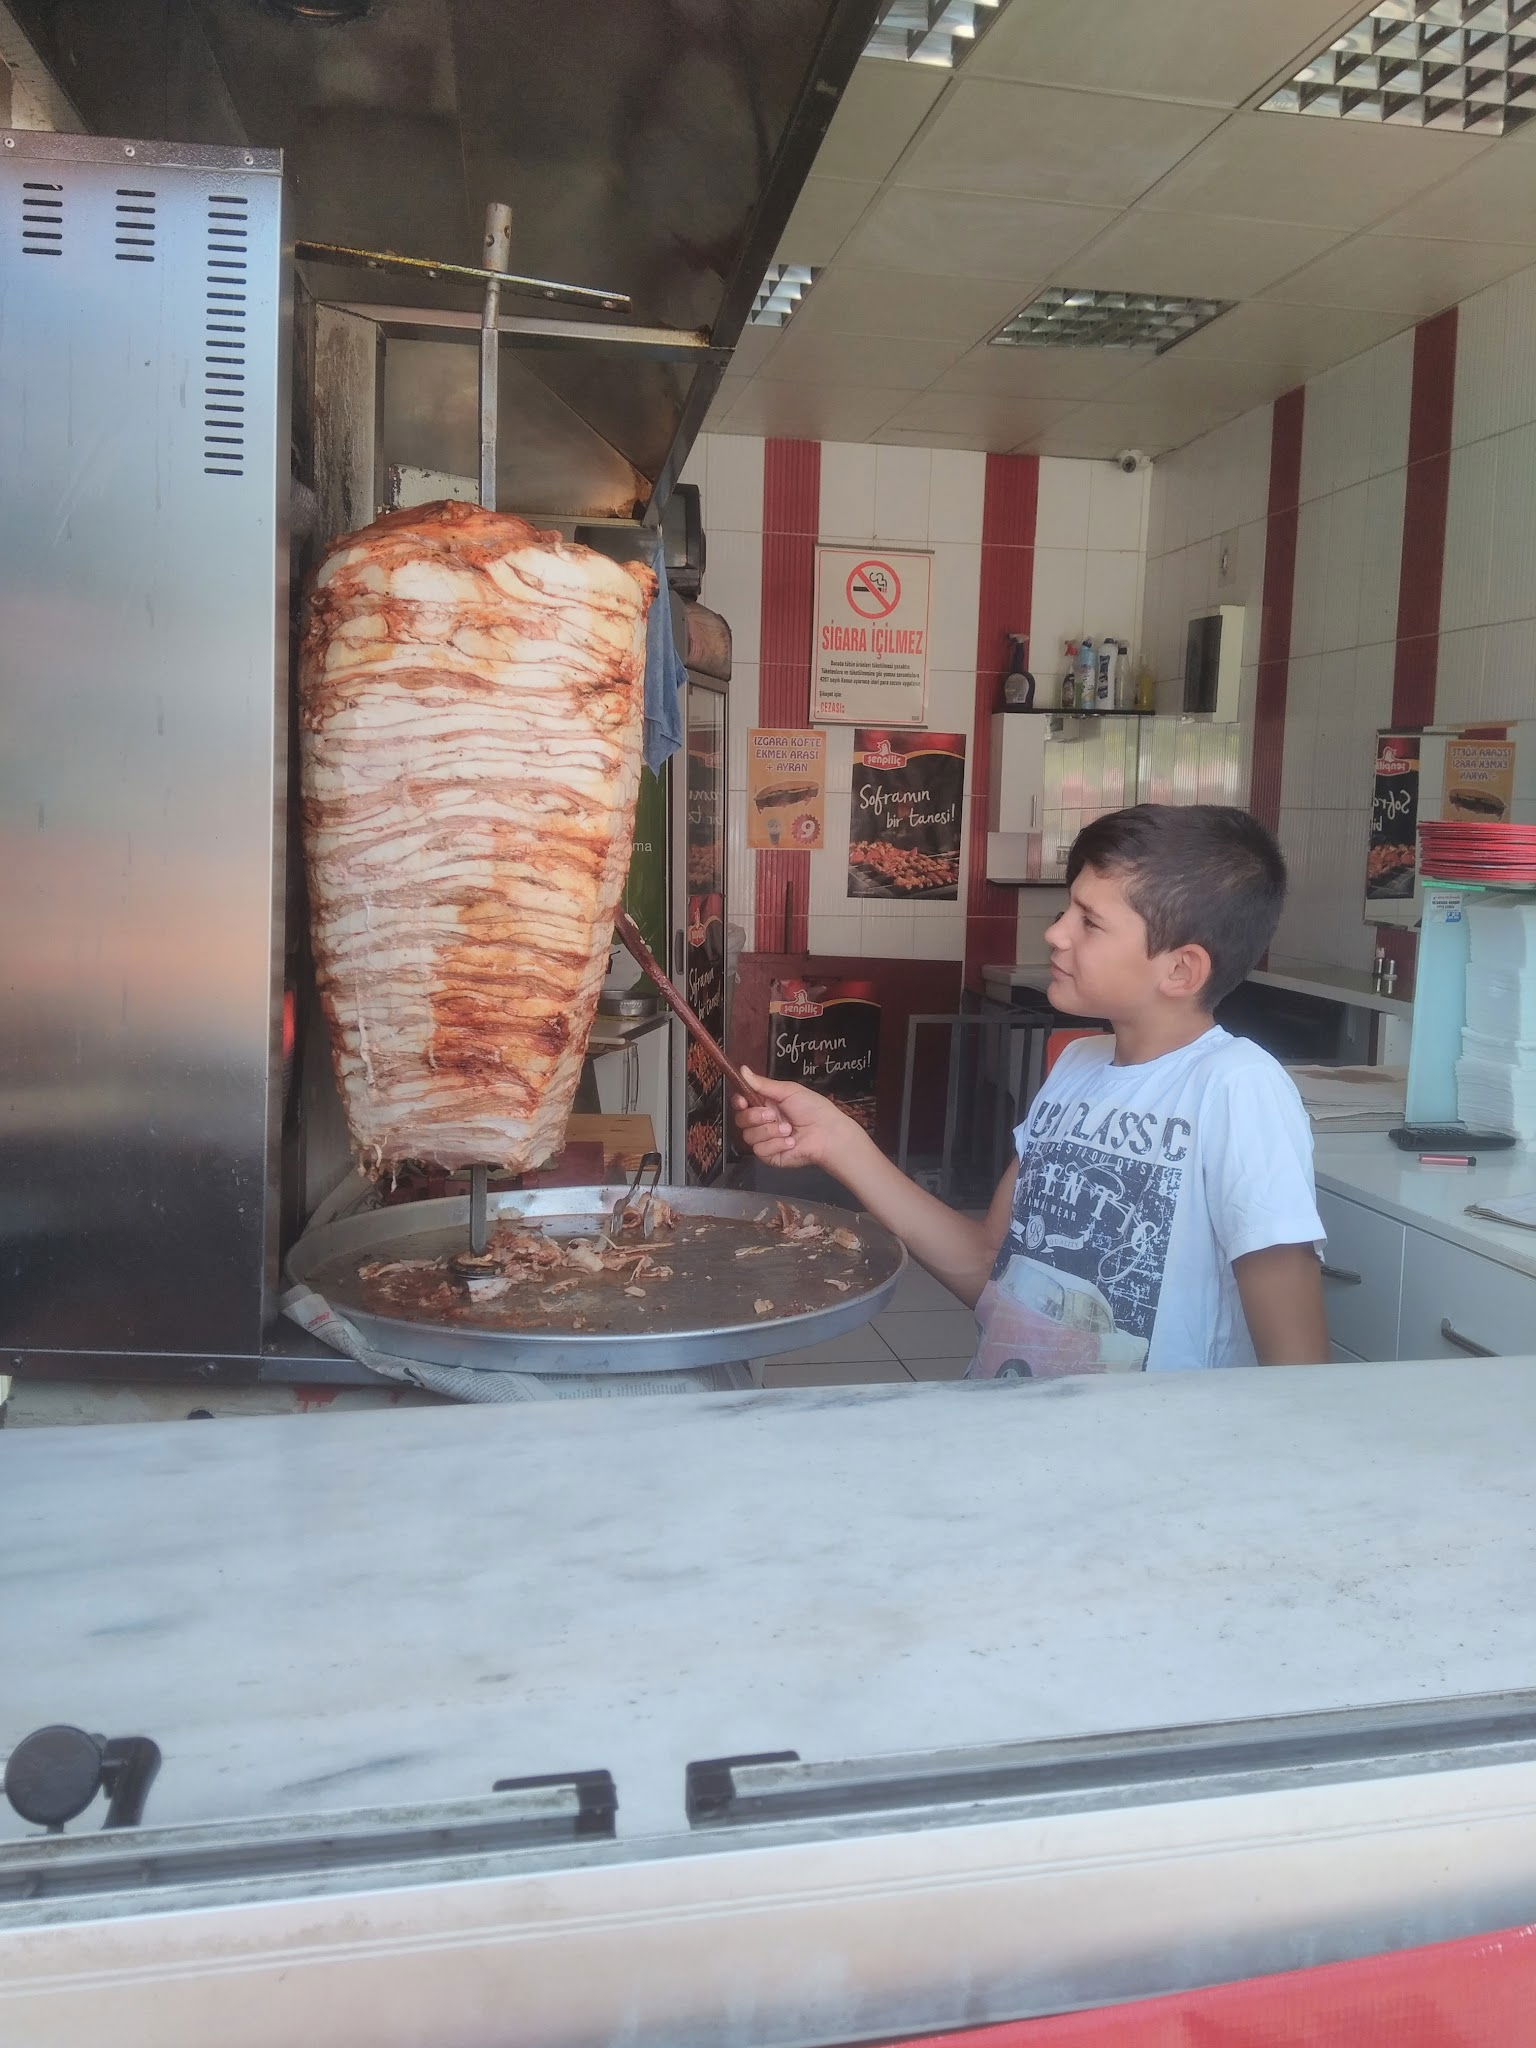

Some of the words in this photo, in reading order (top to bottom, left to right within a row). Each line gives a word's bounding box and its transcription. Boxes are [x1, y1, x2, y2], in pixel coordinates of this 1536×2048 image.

[822, 619, 867, 652] SİGARA
[871, 621, 923, 660] İÇİLMEZ
[754, 737, 788, 747] IZGARA
[756, 750, 788, 759] EKMEK
[789, 751, 819, 760] ARASI
[776, 763, 808, 772] AYRAN
[860, 784, 931, 816] Soframın
[886, 812, 903, 828] bir
[909, 803, 956, 827] tanesi!
[776, 1032, 847, 1064] Soframın
[802, 1058, 819, 1076] bir
[824, 1049, 872, 1074] tanesi!
